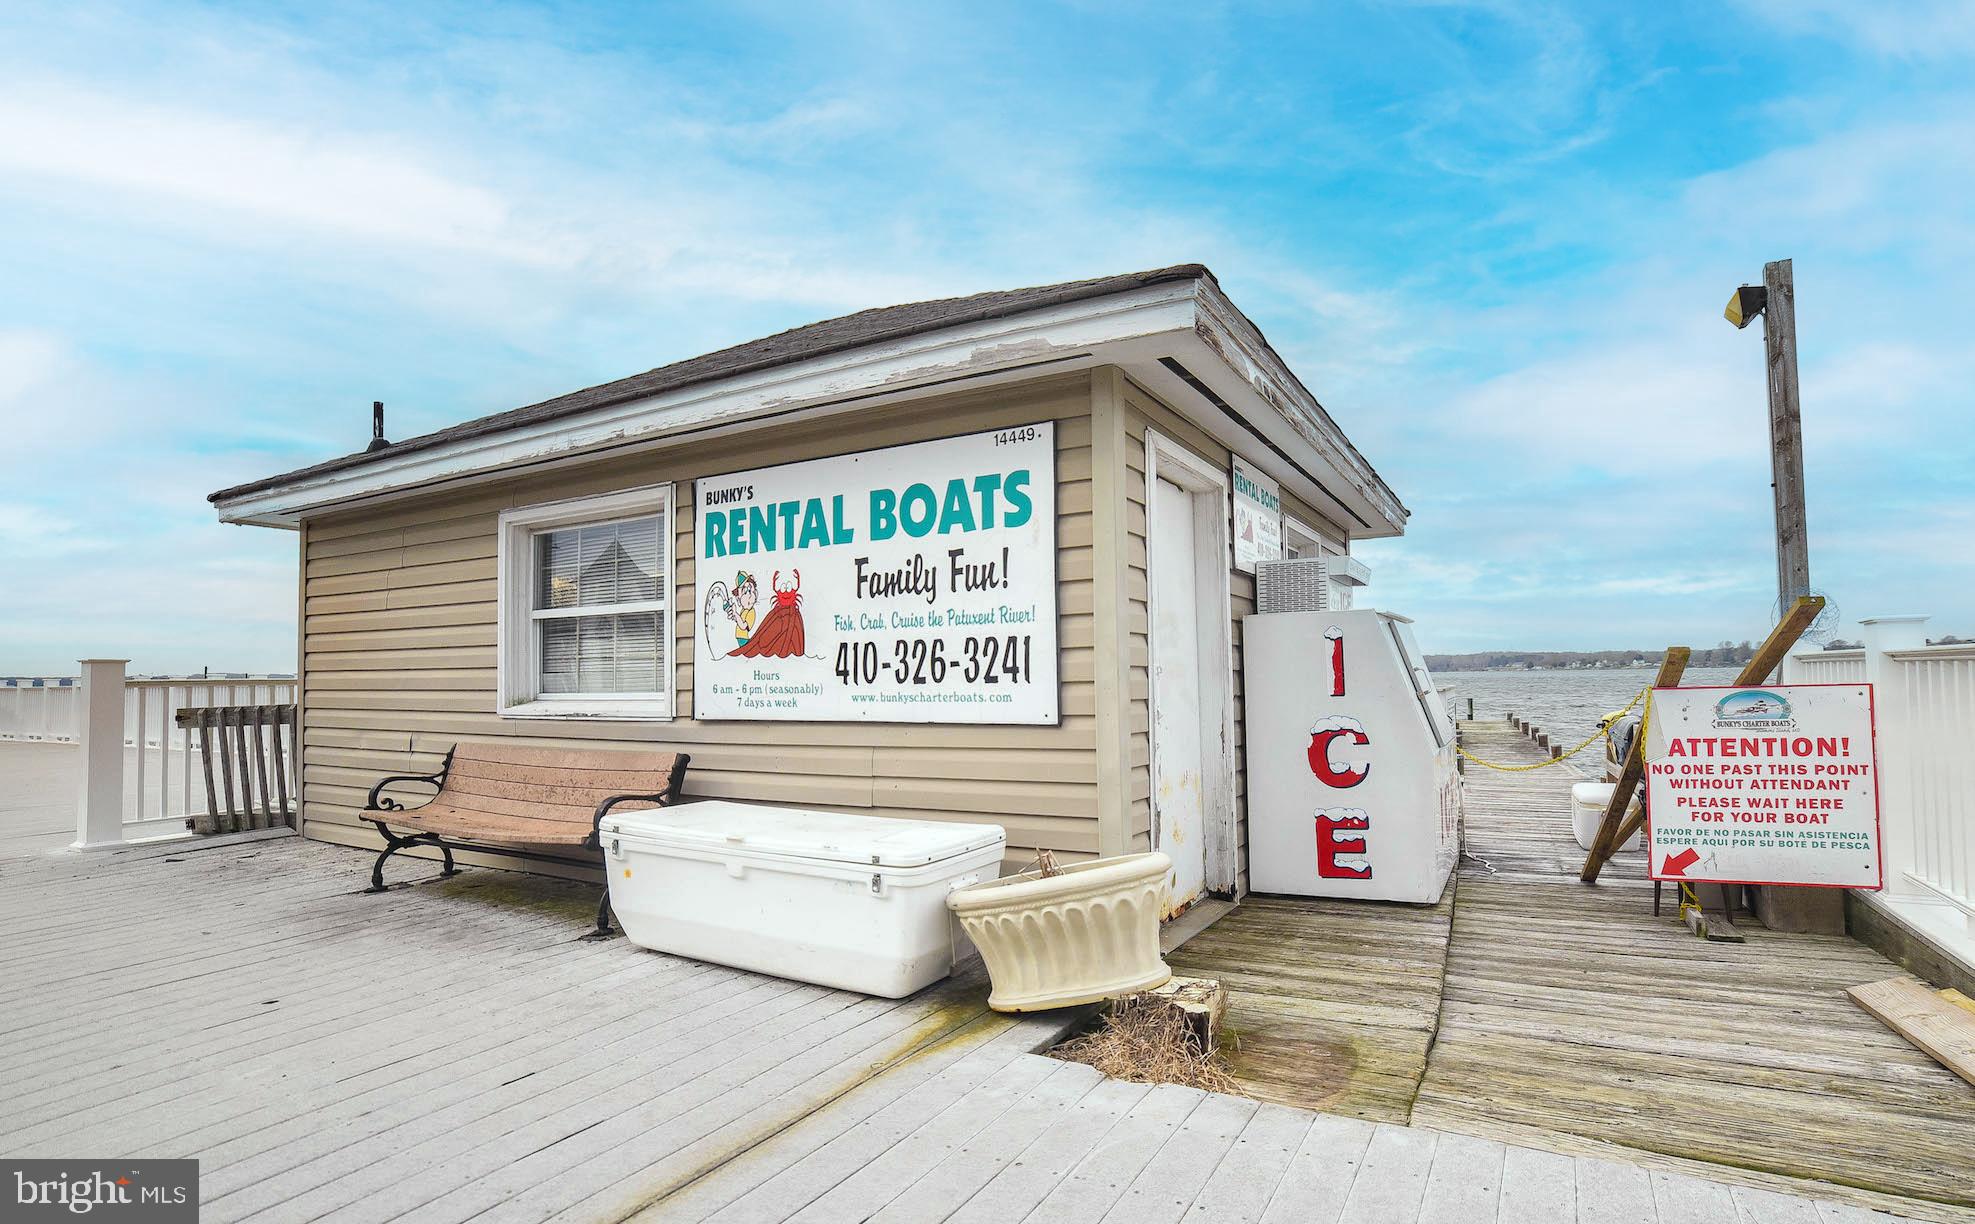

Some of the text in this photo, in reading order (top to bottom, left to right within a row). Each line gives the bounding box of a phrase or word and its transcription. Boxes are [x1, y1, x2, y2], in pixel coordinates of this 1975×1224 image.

[705, 485, 754, 506] BUNKY'S
[705, 469, 1033, 558] RENTAL BOATS
[855, 547, 1009, 605] Family Fun!
[834, 605, 1036, 632] Fish, Crab, Cruise the Patuxent River!
[835, 635, 1031, 686] 410-326-3241
[753, 670, 780, 680] Hours
[712, 684, 717, 694] 6
[742, 684, 747, 693] 6
[749, 687, 762, 695] pm
[765, 683, 823, 695] (seasonably)
[737, 697, 742, 707] 7
[744, 698, 764, 709] days
[775, 697, 798, 707] week
[851, 692, 1012, 704] www.bunkyscharterboats.com
[1668, 737, 1850, 757] ATTENTION!
[1652, 764, 1869, 776] NO ONE PAST THIS POINT
[1669, 779, 1851, 791] WITHOUT ATTENDANT
[1677, 797, 1844, 809] PLEASE WAIT HERE
[1691, 812, 1829, 824] FOR YOUR BOAT
[1657, 828, 1692, 836] FAVOR
[1713, 829, 1729, 837] NO
[1733, 829, 1770, 837] PASAR
[1775, 830, 1794, 838] SIN
[1798, 831, 1869, 840] ASISTENCIA
[1656, 837, 1699, 845] ESPERE
[1732, 839, 1755, 847] POR
[1778, 840, 1808, 848] BOTE
[1812, 841, 1827, 849] DE
[1831, 841, 1870, 850] PESCA
